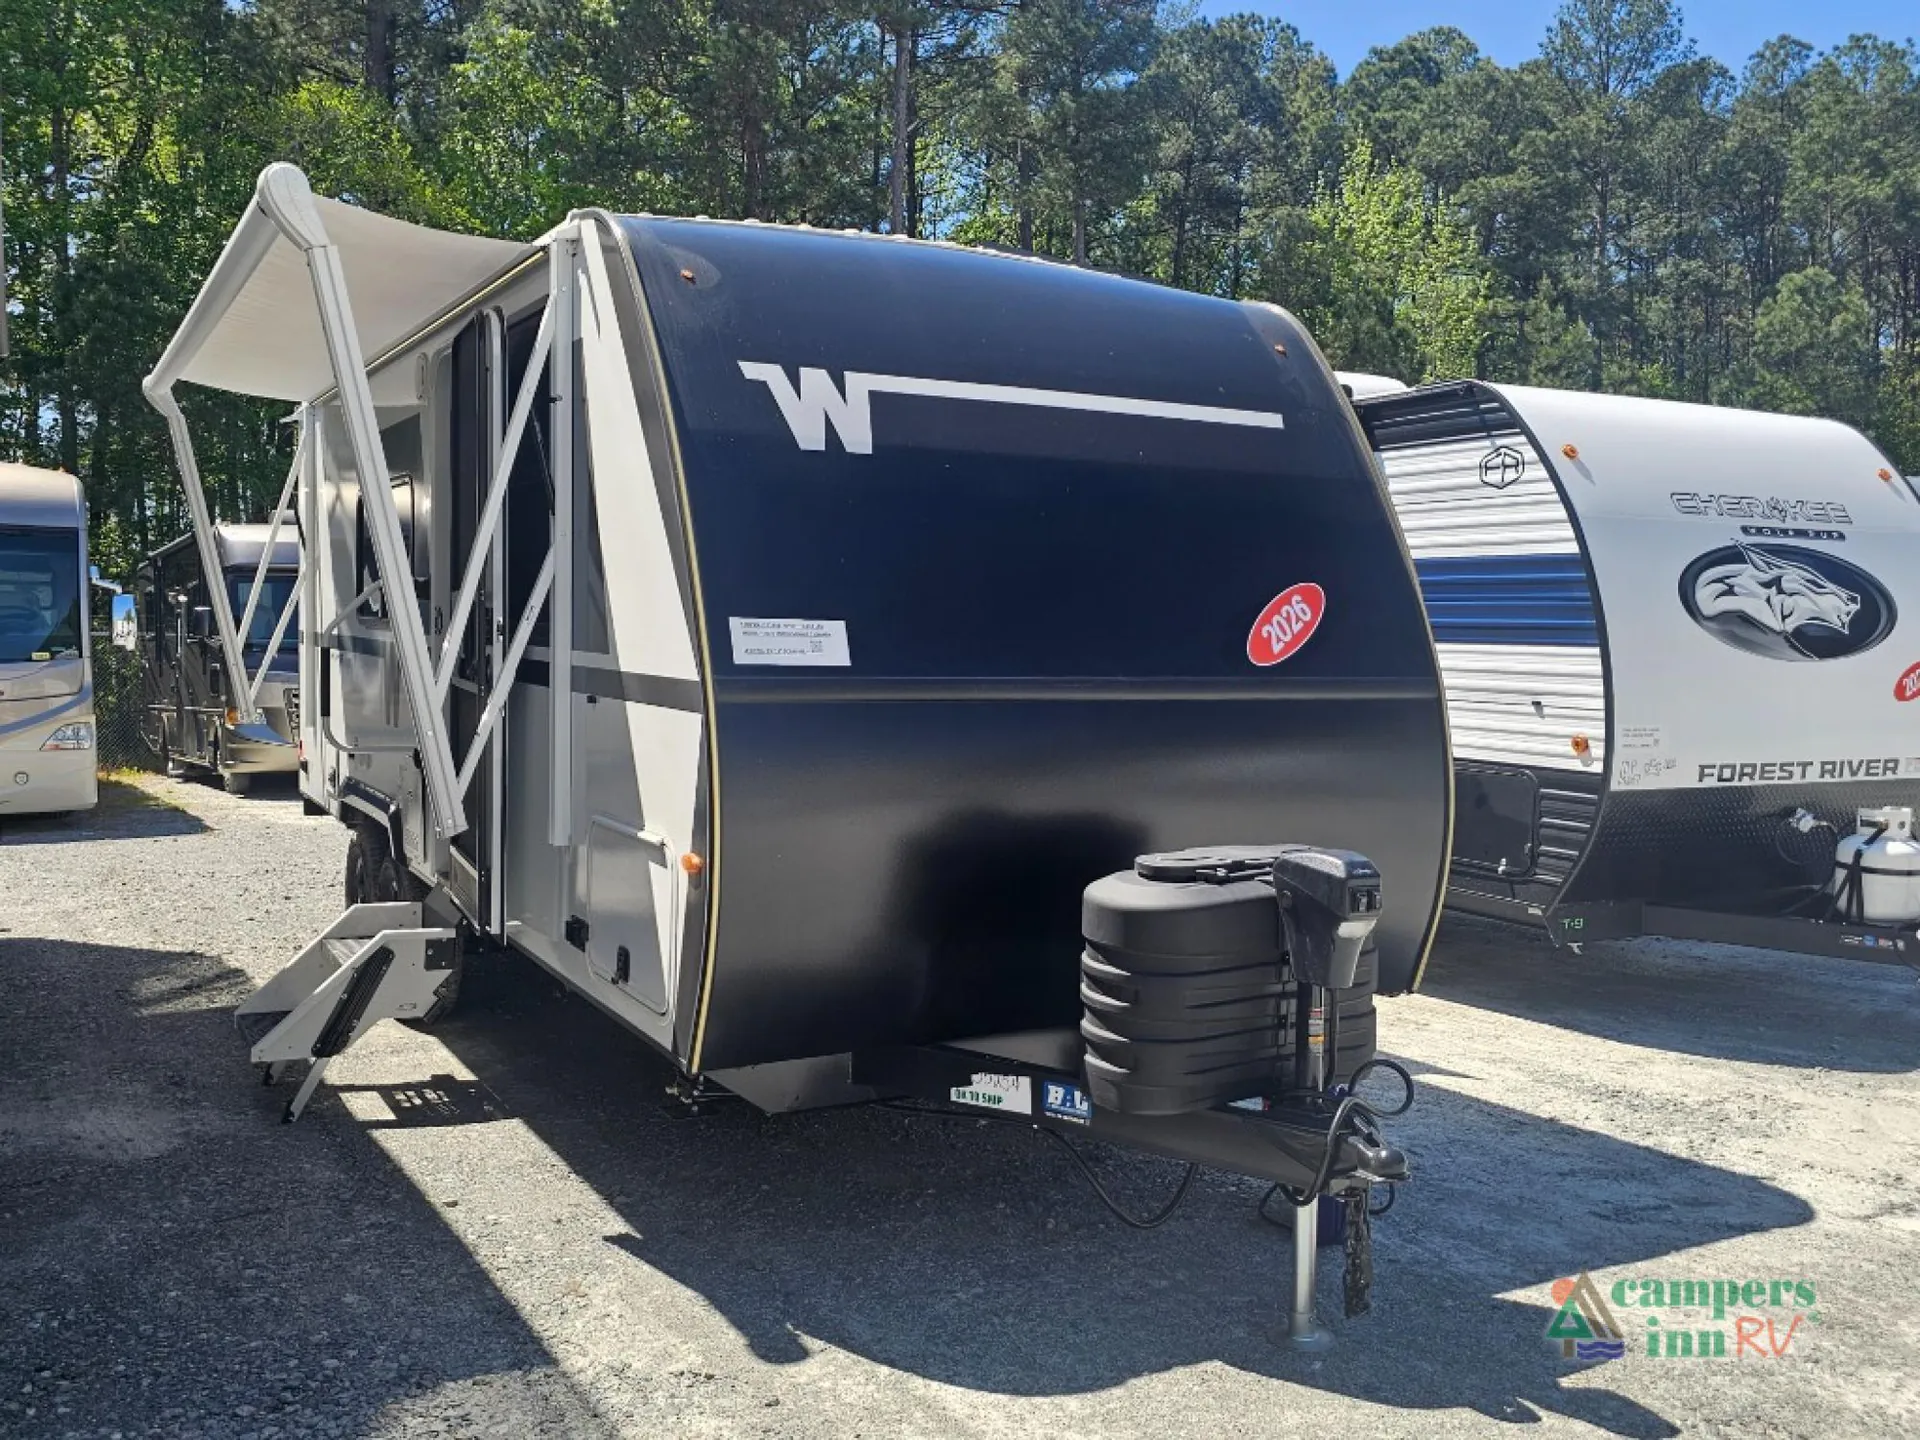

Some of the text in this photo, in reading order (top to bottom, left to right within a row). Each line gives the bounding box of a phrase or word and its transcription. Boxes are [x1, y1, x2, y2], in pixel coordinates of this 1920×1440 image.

[1670, 492, 1853, 524] CHEROKEE
[1261, 594, 1312, 655] 2026
[1698, 759, 1814, 783] FOREST
[1819, 757, 1900, 779] RIVER
[981, 1092, 1004, 1106] SHIP
